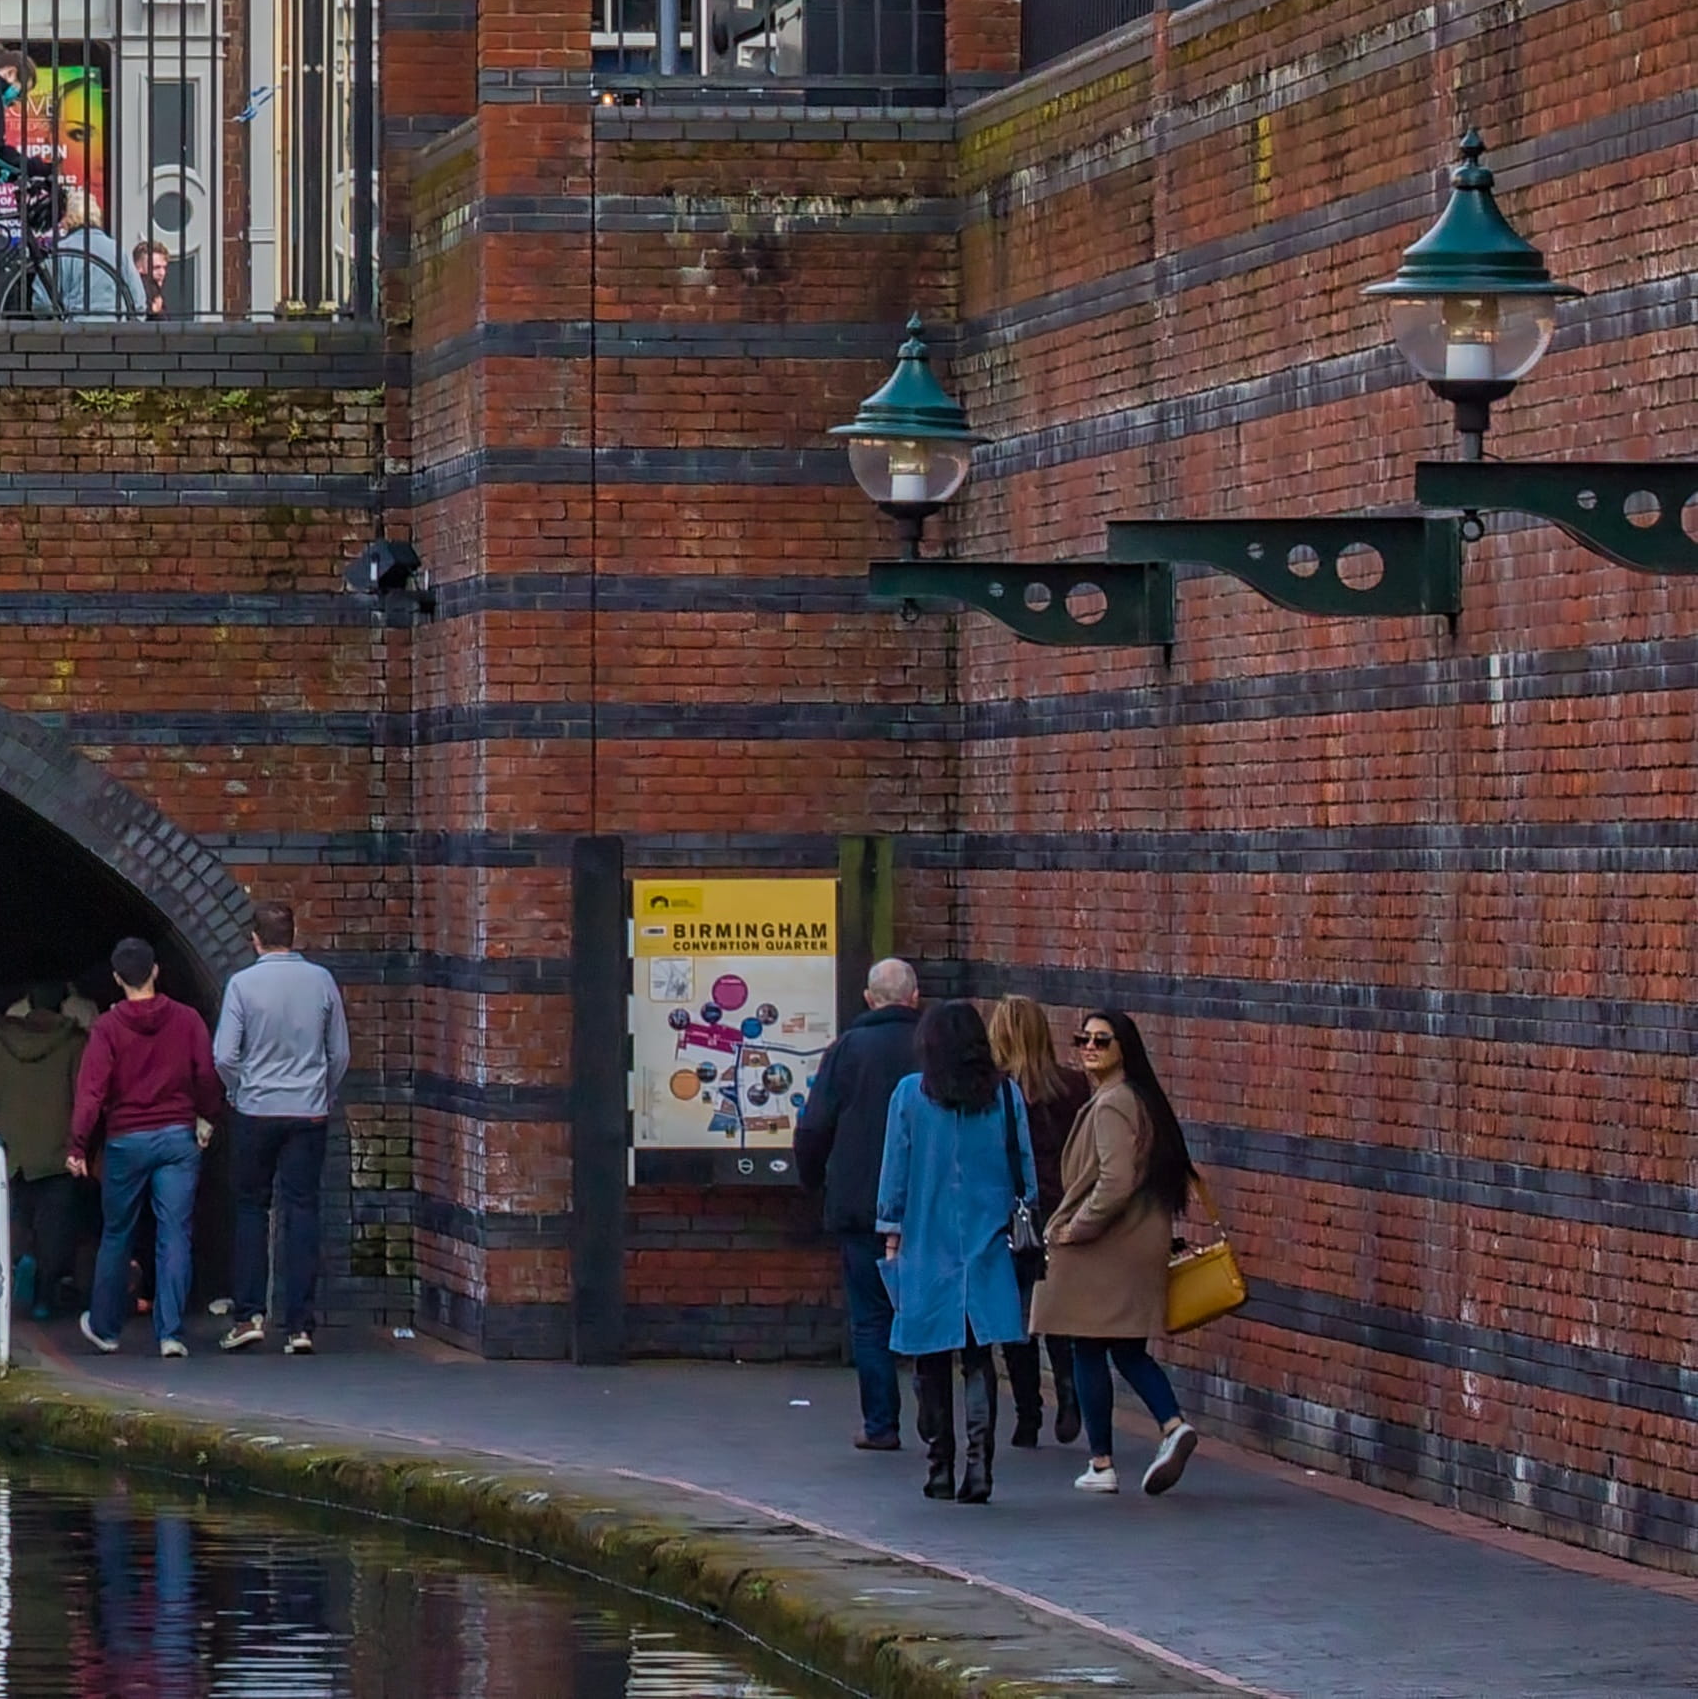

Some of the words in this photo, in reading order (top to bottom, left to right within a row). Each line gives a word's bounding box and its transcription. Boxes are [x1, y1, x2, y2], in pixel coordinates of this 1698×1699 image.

[673, 923, 827, 939] BIRMINGHAM
[673, 941, 760, 951] CONVENTION
[765, 941, 828, 951] QUARTER
